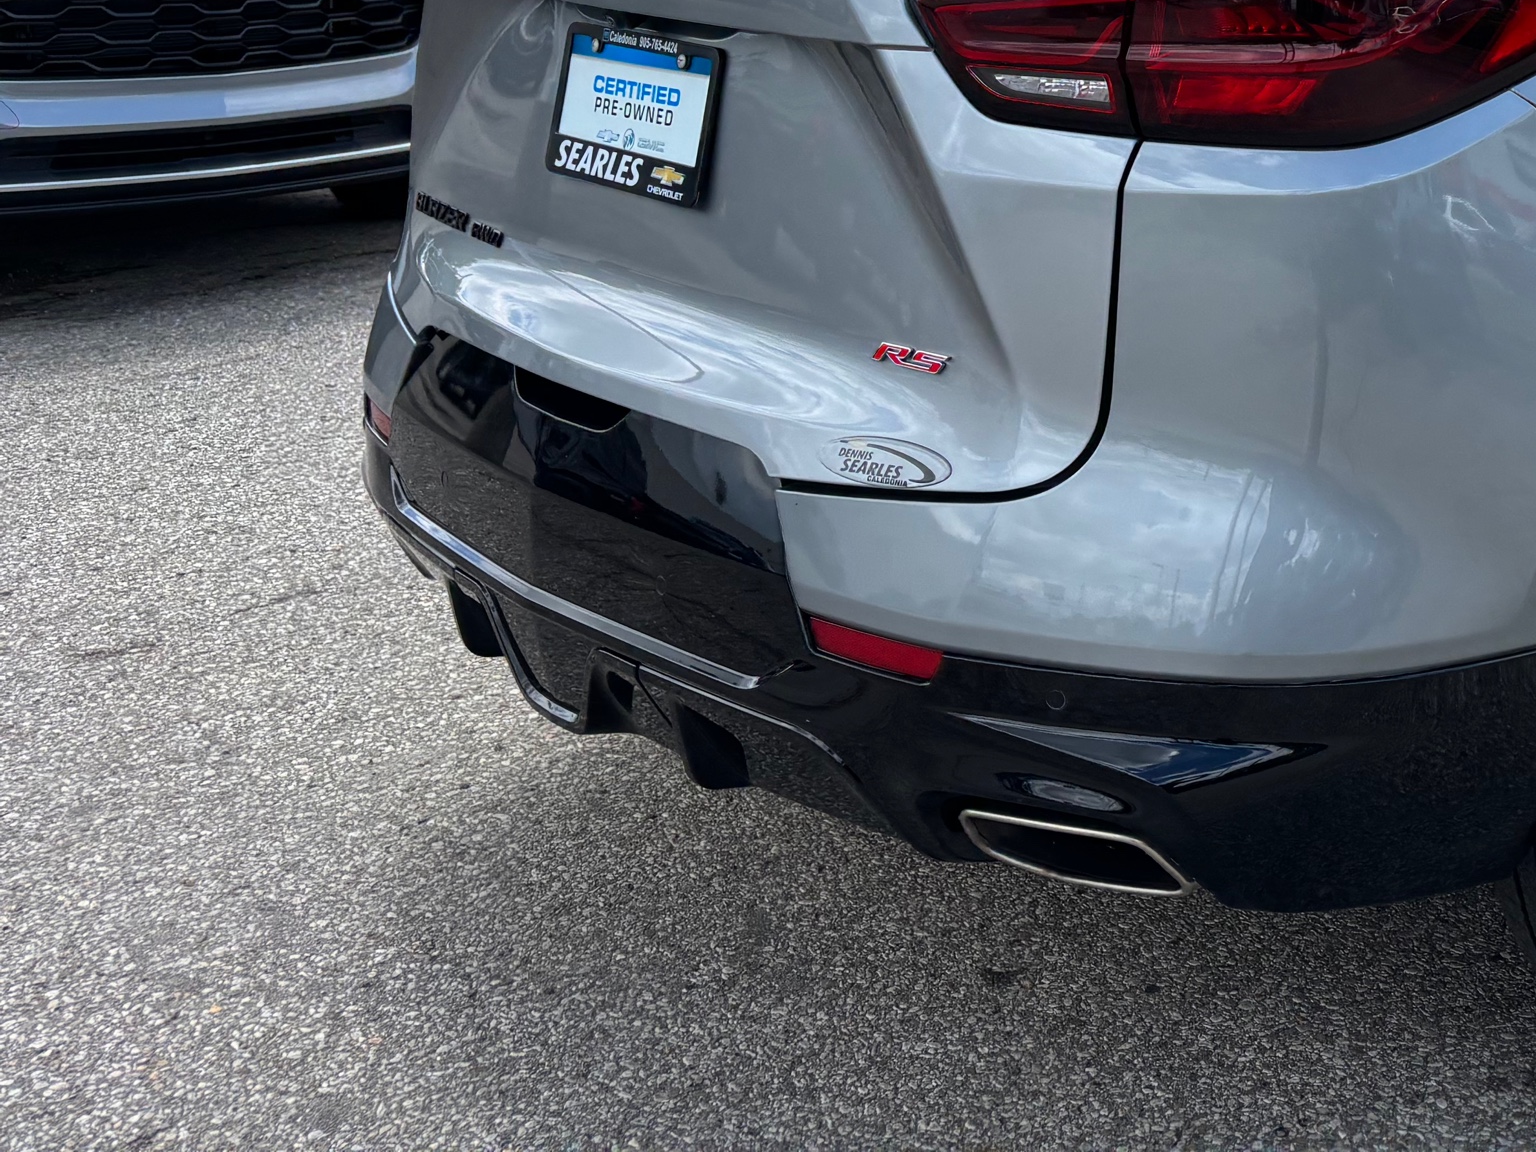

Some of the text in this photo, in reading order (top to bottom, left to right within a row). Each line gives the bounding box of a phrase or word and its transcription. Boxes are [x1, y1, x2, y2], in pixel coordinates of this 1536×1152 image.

[609, 30, 678, 54] Caledonia 905-765-4424
[593, 74, 681, 107] CERTIFIED
[594, 97, 674, 127] PRE-OWNED
[554, 139, 644, 186] SEARLES
[647, 184, 684, 201] CHEVROLET
[871, 341, 952, 375] RS
[838, 447, 873, 461] DENNIS
[840, 459, 903, 479] SEARLES
[866, 475, 908, 488] CALEDONIA
